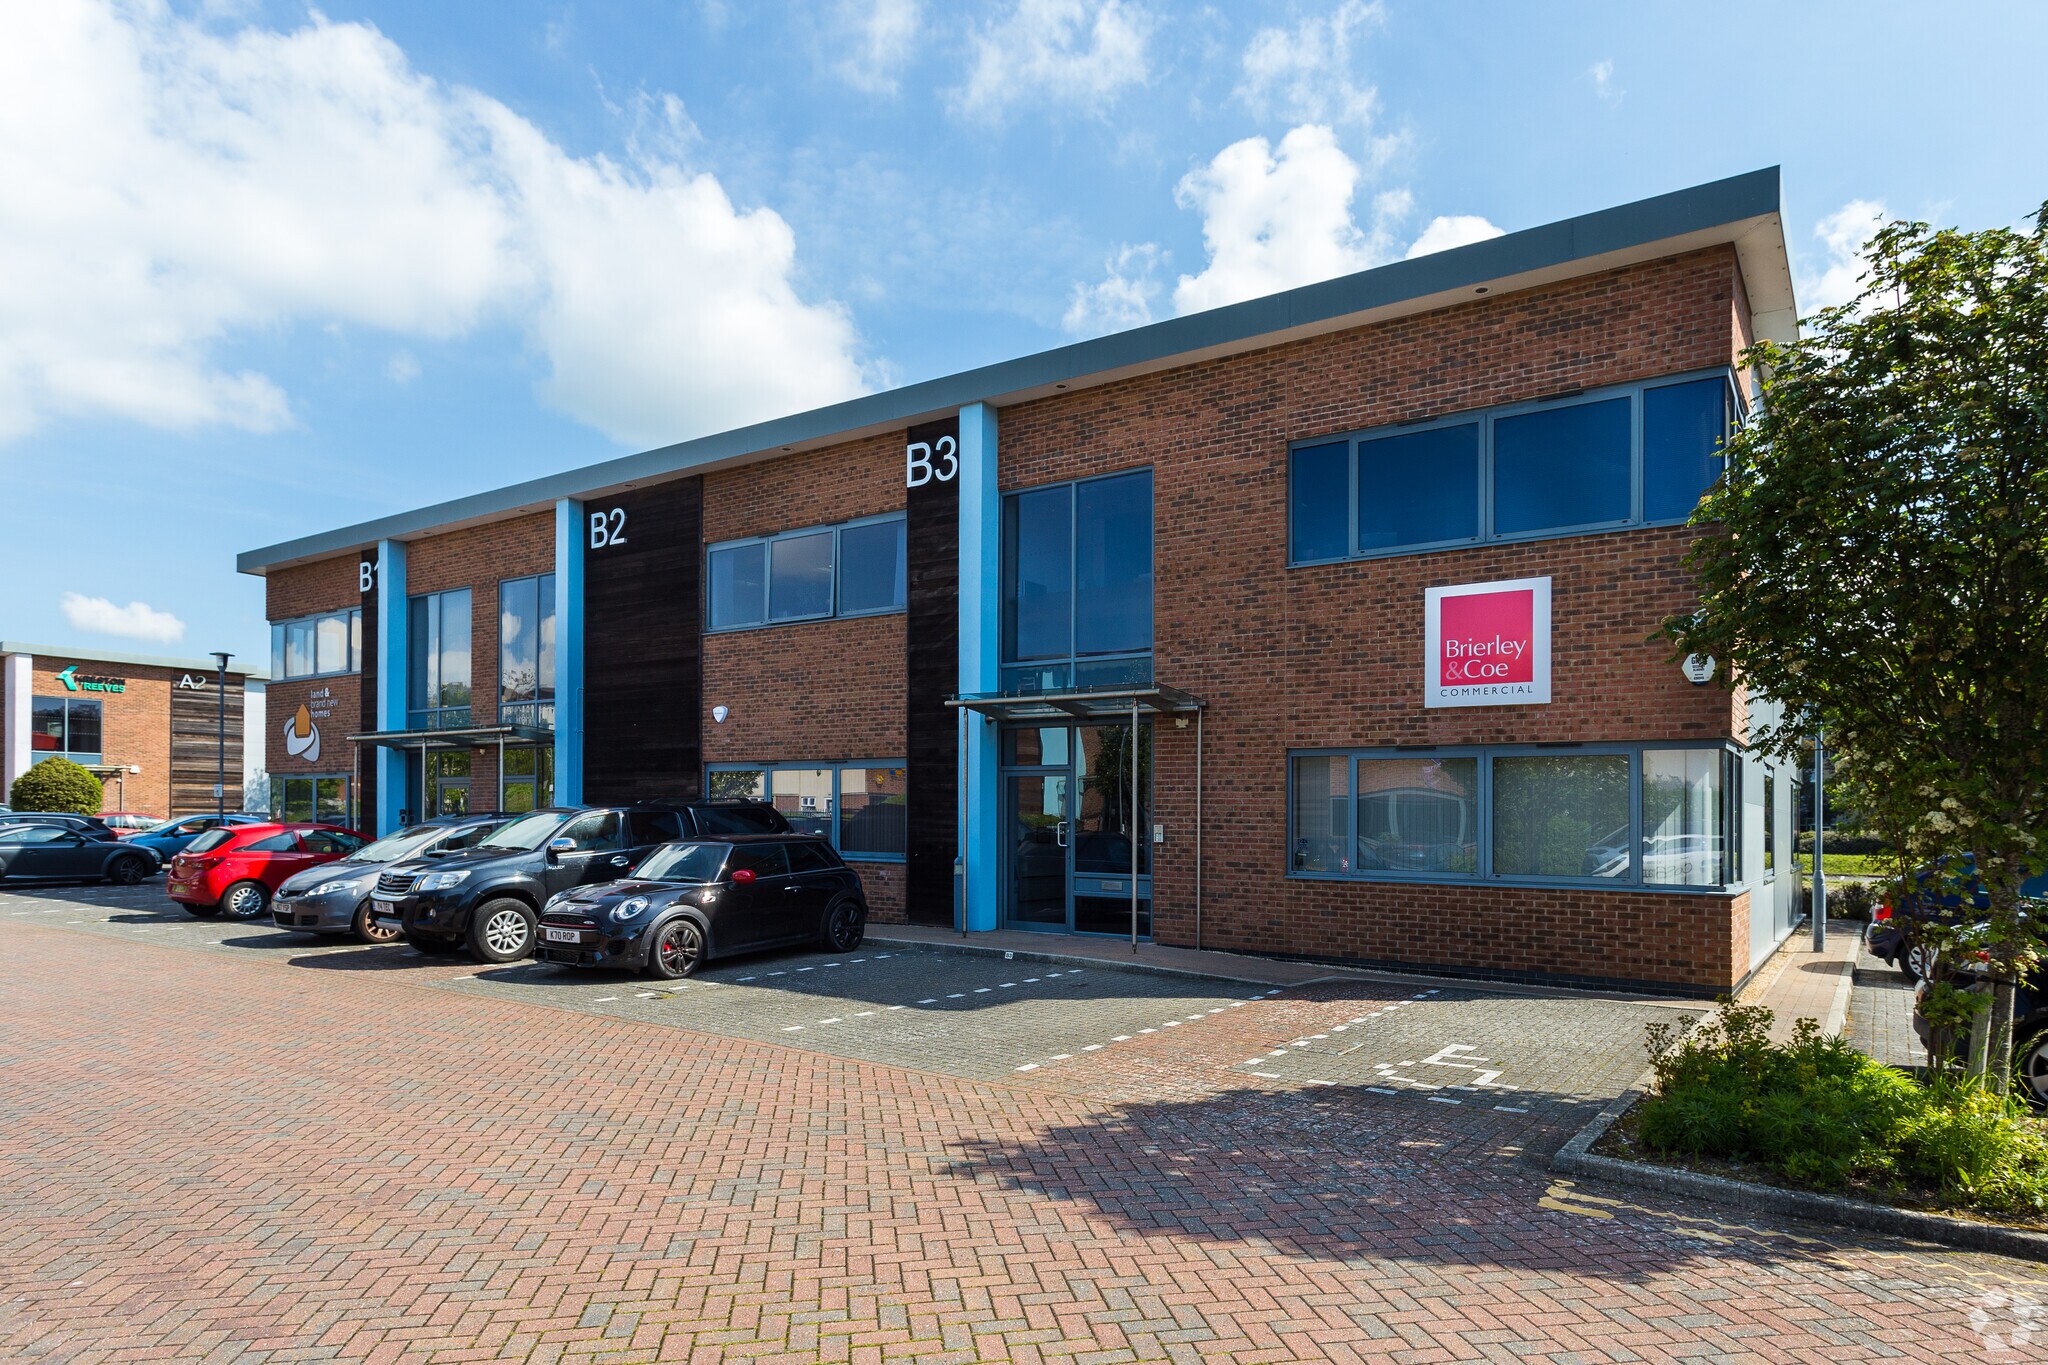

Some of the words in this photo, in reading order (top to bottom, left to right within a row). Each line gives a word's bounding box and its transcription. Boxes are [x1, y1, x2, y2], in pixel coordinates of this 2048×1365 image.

[906, 435, 958, 488] B3
[590, 508, 627, 549] B2
[1446, 635, 1527, 660] Brierley
[179, 674, 206, 689] A2
[83, 682, 126, 693] REEVES
[310, 689, 324, 698] land
[324, 687, 330, 697] &
[1440, 686, 1533, 697] COMMERCIAL
[310, 709, 330, 718] homes
[550, 930, 561, 939] K70
[563, 931, 575, 941] ROP
